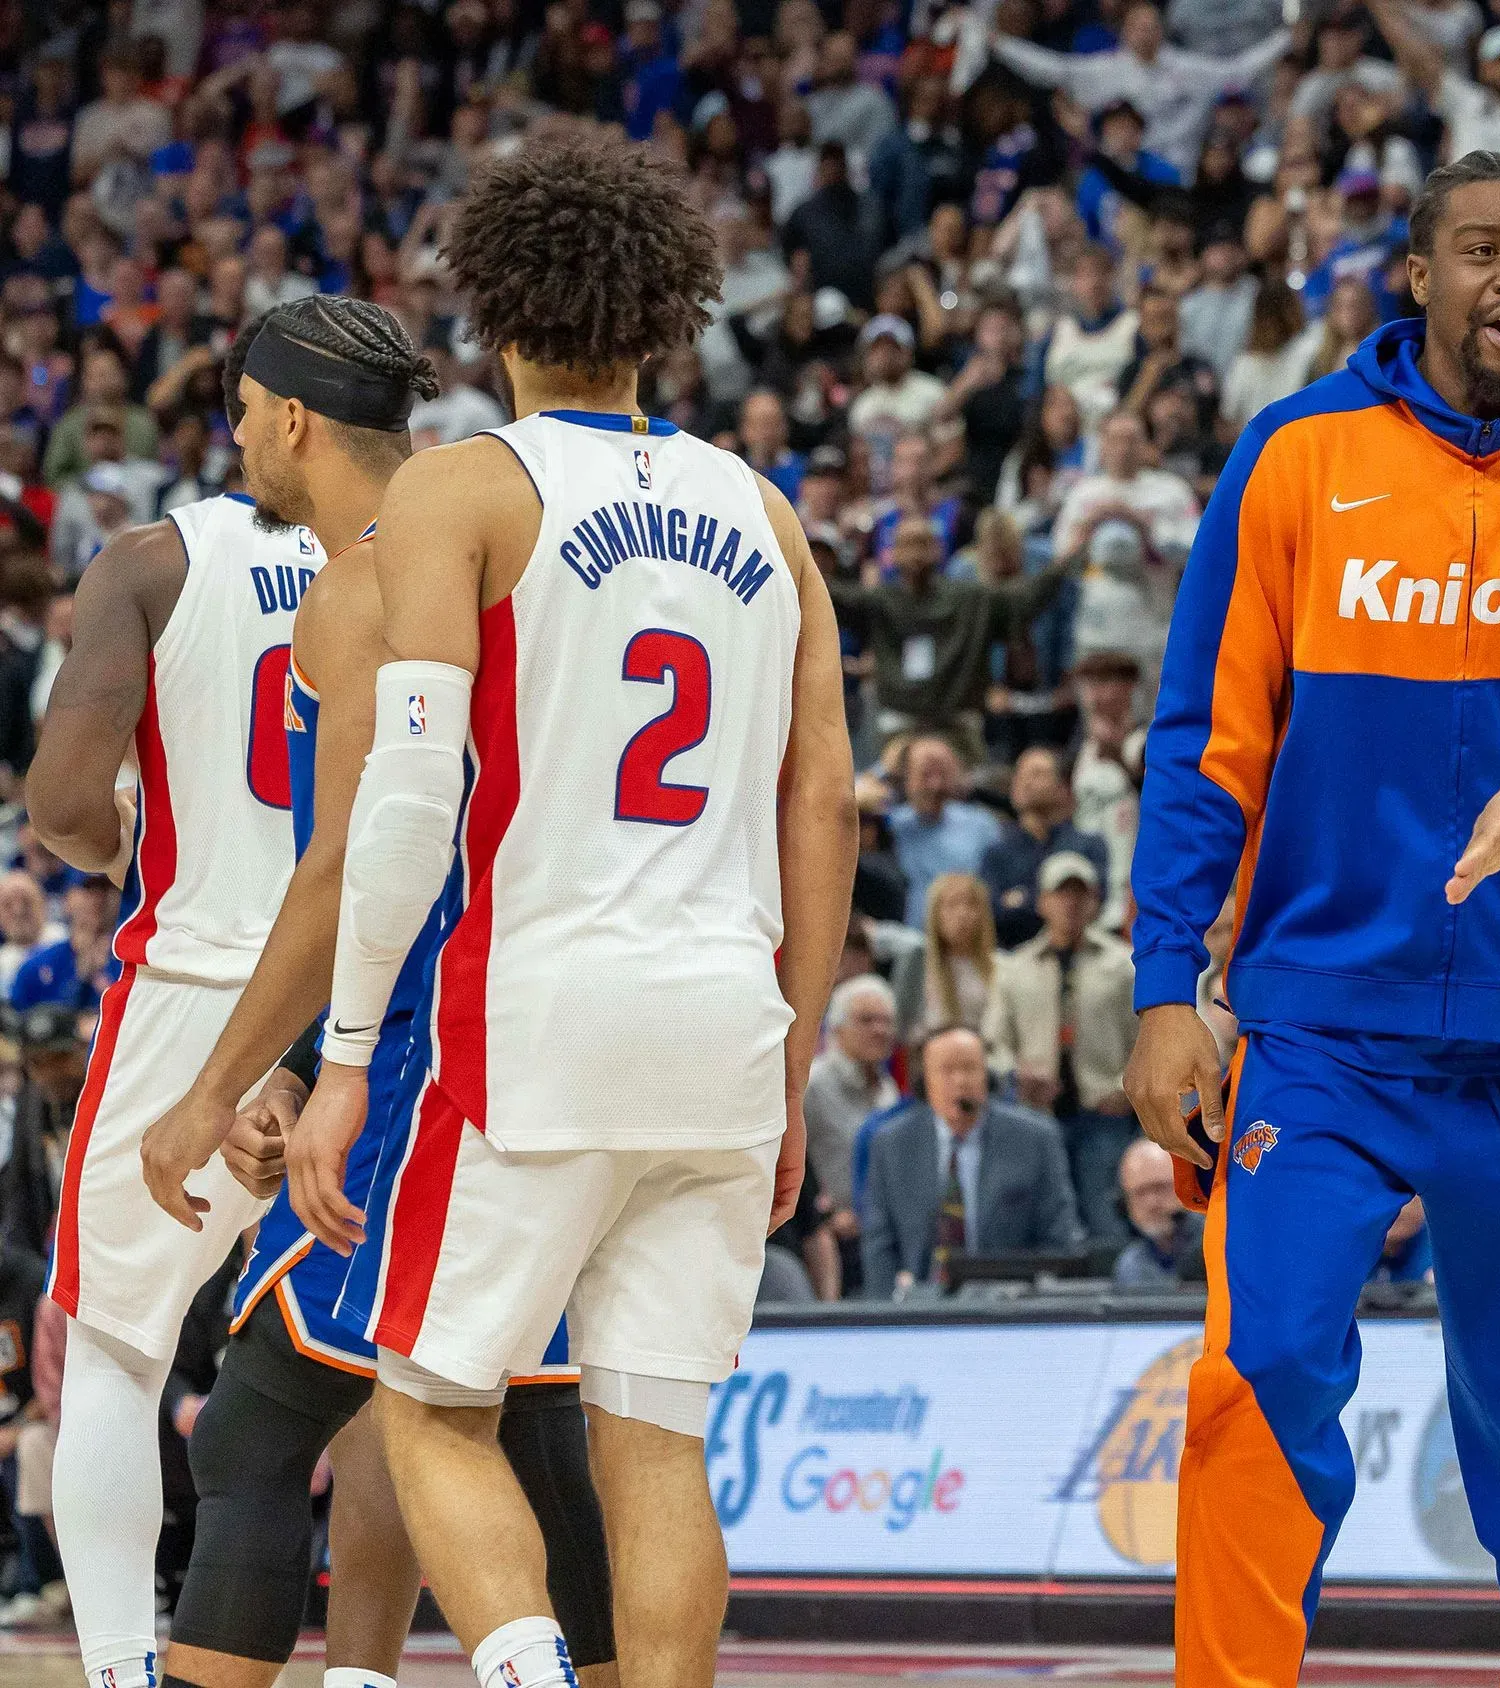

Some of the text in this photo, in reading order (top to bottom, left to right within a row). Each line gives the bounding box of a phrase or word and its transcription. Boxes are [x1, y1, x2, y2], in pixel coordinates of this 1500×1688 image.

[560, 501, 775, 606] CUNNINGHAM
[613, 627, 712, 828] 2
[780, 1445, 966, 1533] Google
